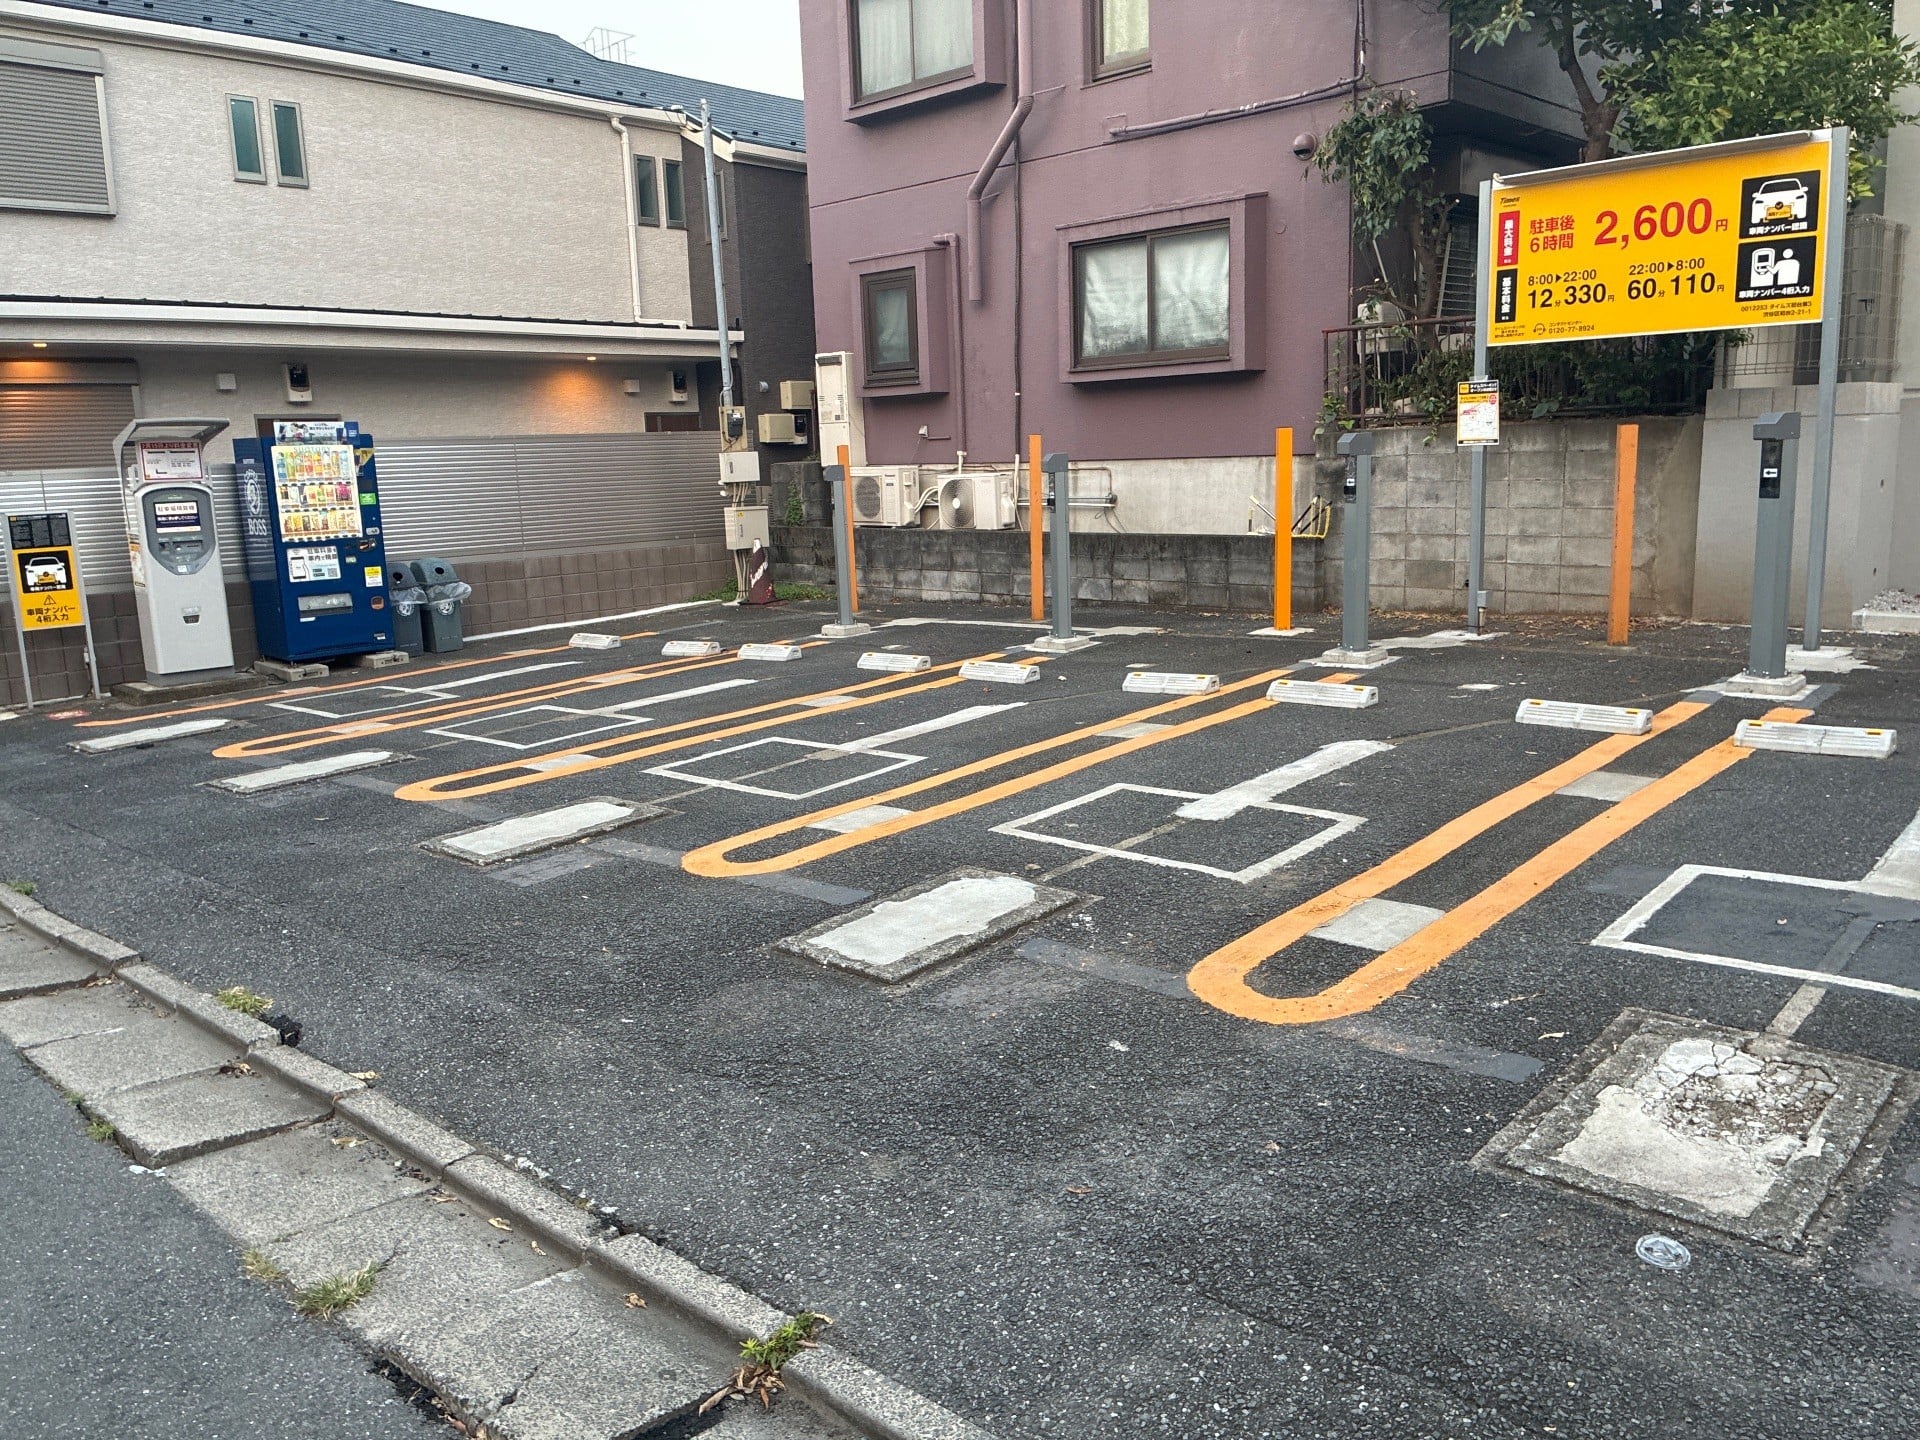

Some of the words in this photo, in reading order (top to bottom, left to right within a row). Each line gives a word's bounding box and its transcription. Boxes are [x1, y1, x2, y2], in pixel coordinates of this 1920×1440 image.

[1530, 215, 1575, 235] 駐車後
[1530, 233, 1574, 253] 6時間
[247, 518, 268, 536] BOSS
[26, 604, 76, 617] 車両ナンバー
[35, 613, 69, 624] 4桁入力
